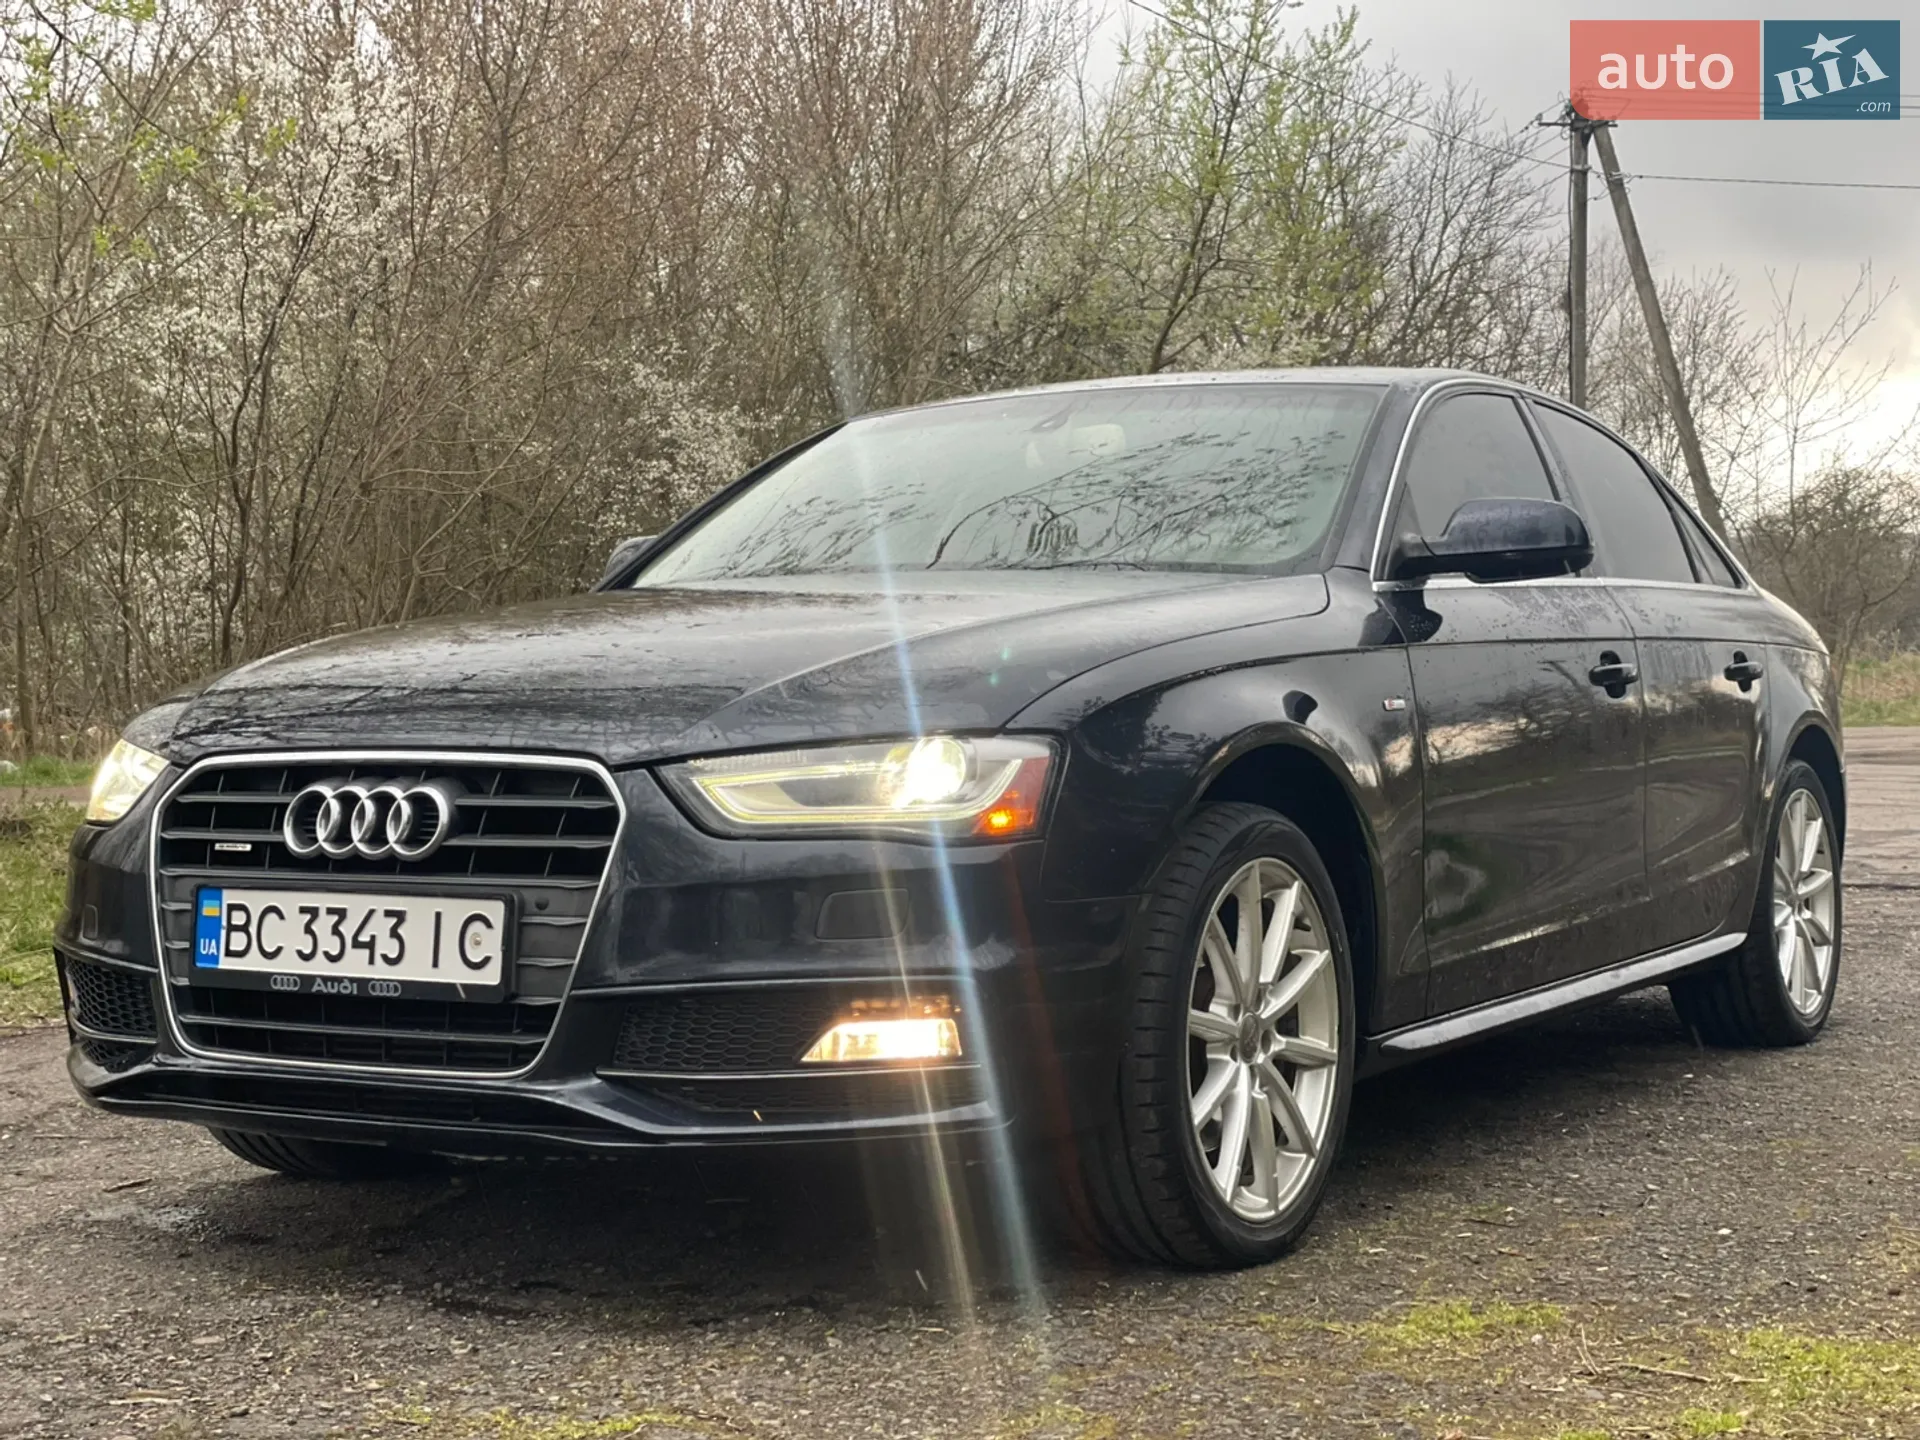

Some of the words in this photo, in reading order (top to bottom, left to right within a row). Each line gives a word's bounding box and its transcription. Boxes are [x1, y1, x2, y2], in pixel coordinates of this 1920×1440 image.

[224, 902, 286, 960] BC
[295, 905, 407, 967] 3343
[431, 911, 494, 971] IC
[200, 938, 218, 955] UA
[311, 977, 358, 995] Audi
